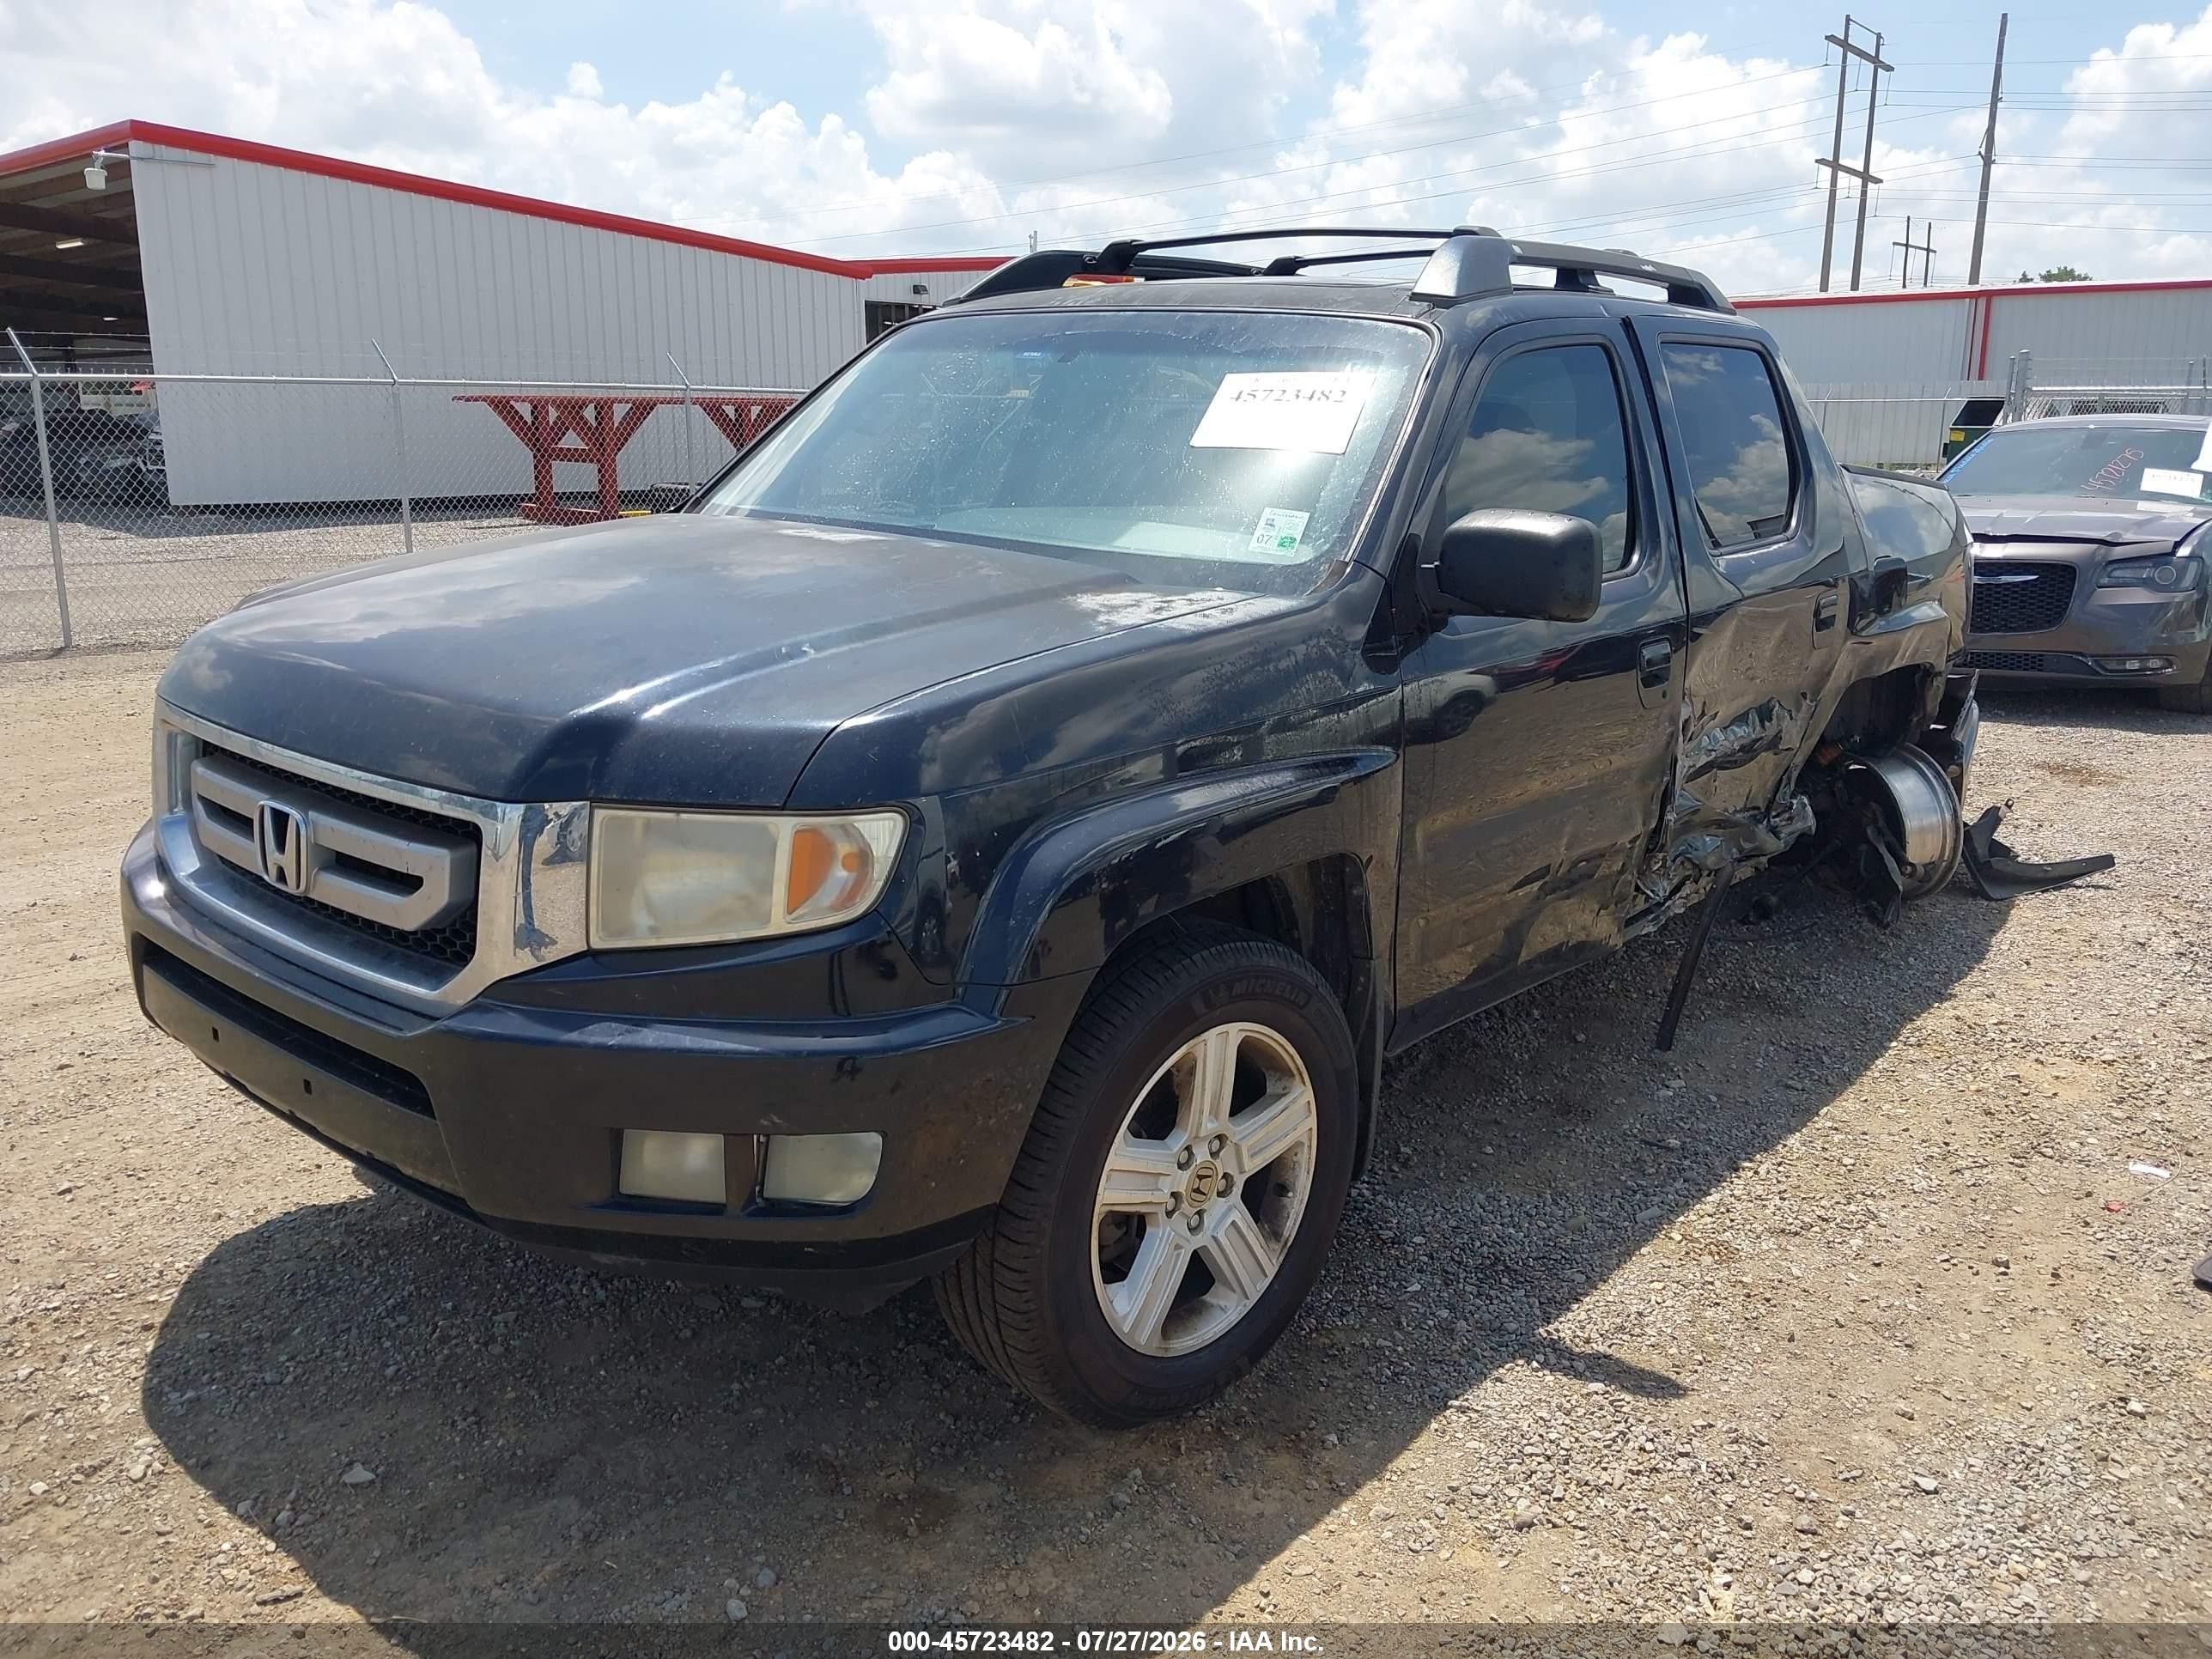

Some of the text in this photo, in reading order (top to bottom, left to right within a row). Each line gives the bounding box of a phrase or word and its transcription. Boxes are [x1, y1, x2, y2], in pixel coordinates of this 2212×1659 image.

[1230, 389, 1347, 403] 45723482
[1256, 534, 1273, 545] 07
[1231, 978, 1307, 1006] MICHELIN
